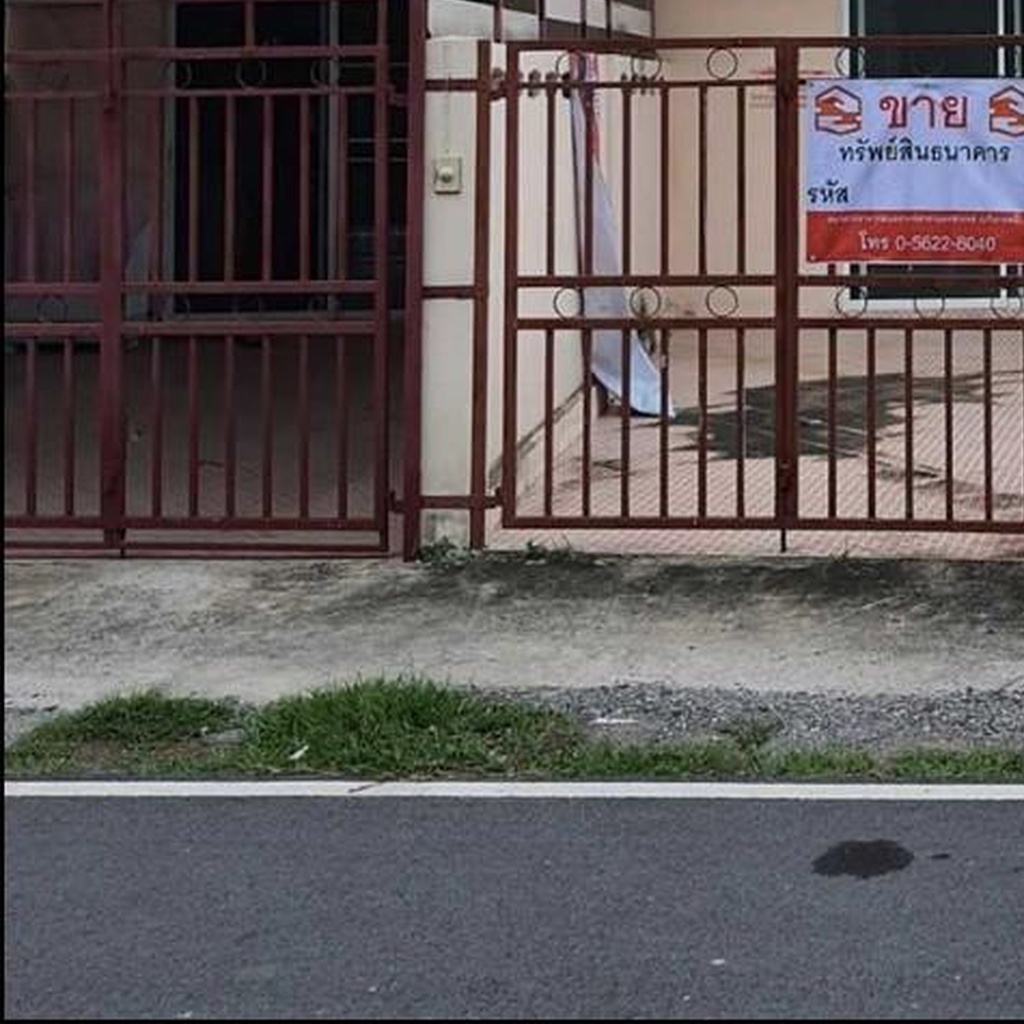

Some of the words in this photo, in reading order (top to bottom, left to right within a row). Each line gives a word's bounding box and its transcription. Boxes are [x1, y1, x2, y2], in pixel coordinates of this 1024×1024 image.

[879, 95, 968, 128] ขาย
[839, 136, 1011, 162] ทรัพย์สินธนาคาร
[807, 179, 849, 204] รหัส
[858, 232, 888, 250] โทร
